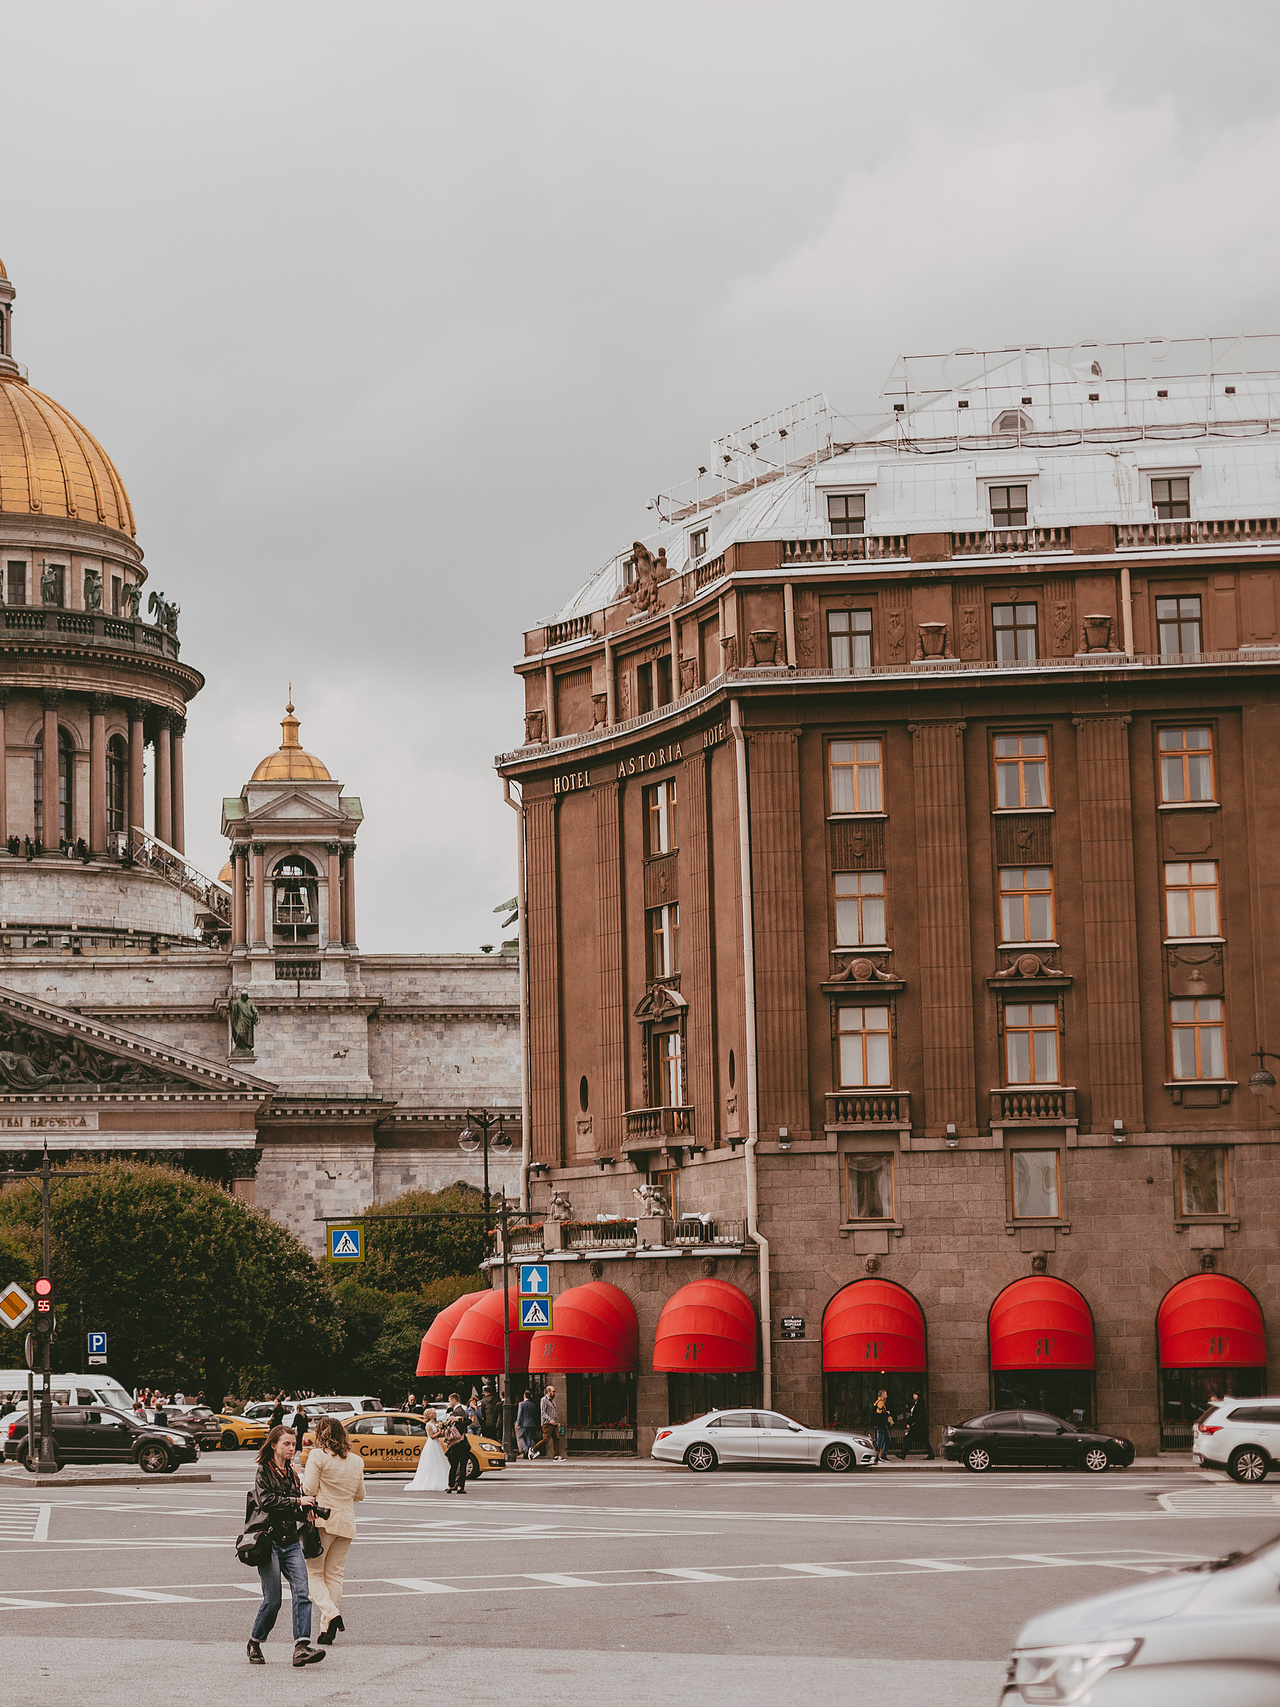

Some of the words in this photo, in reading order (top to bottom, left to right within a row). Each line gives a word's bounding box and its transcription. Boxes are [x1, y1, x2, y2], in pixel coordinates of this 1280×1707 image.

[553, 770, 592, 794] HOTEL
[618, 742, 684, 778] ASTORIA
[37, 1299, 51, 1313] 55
[92, 1335, 104, 1352] P
[360, 1445, 424, 1457] Ситимоб
